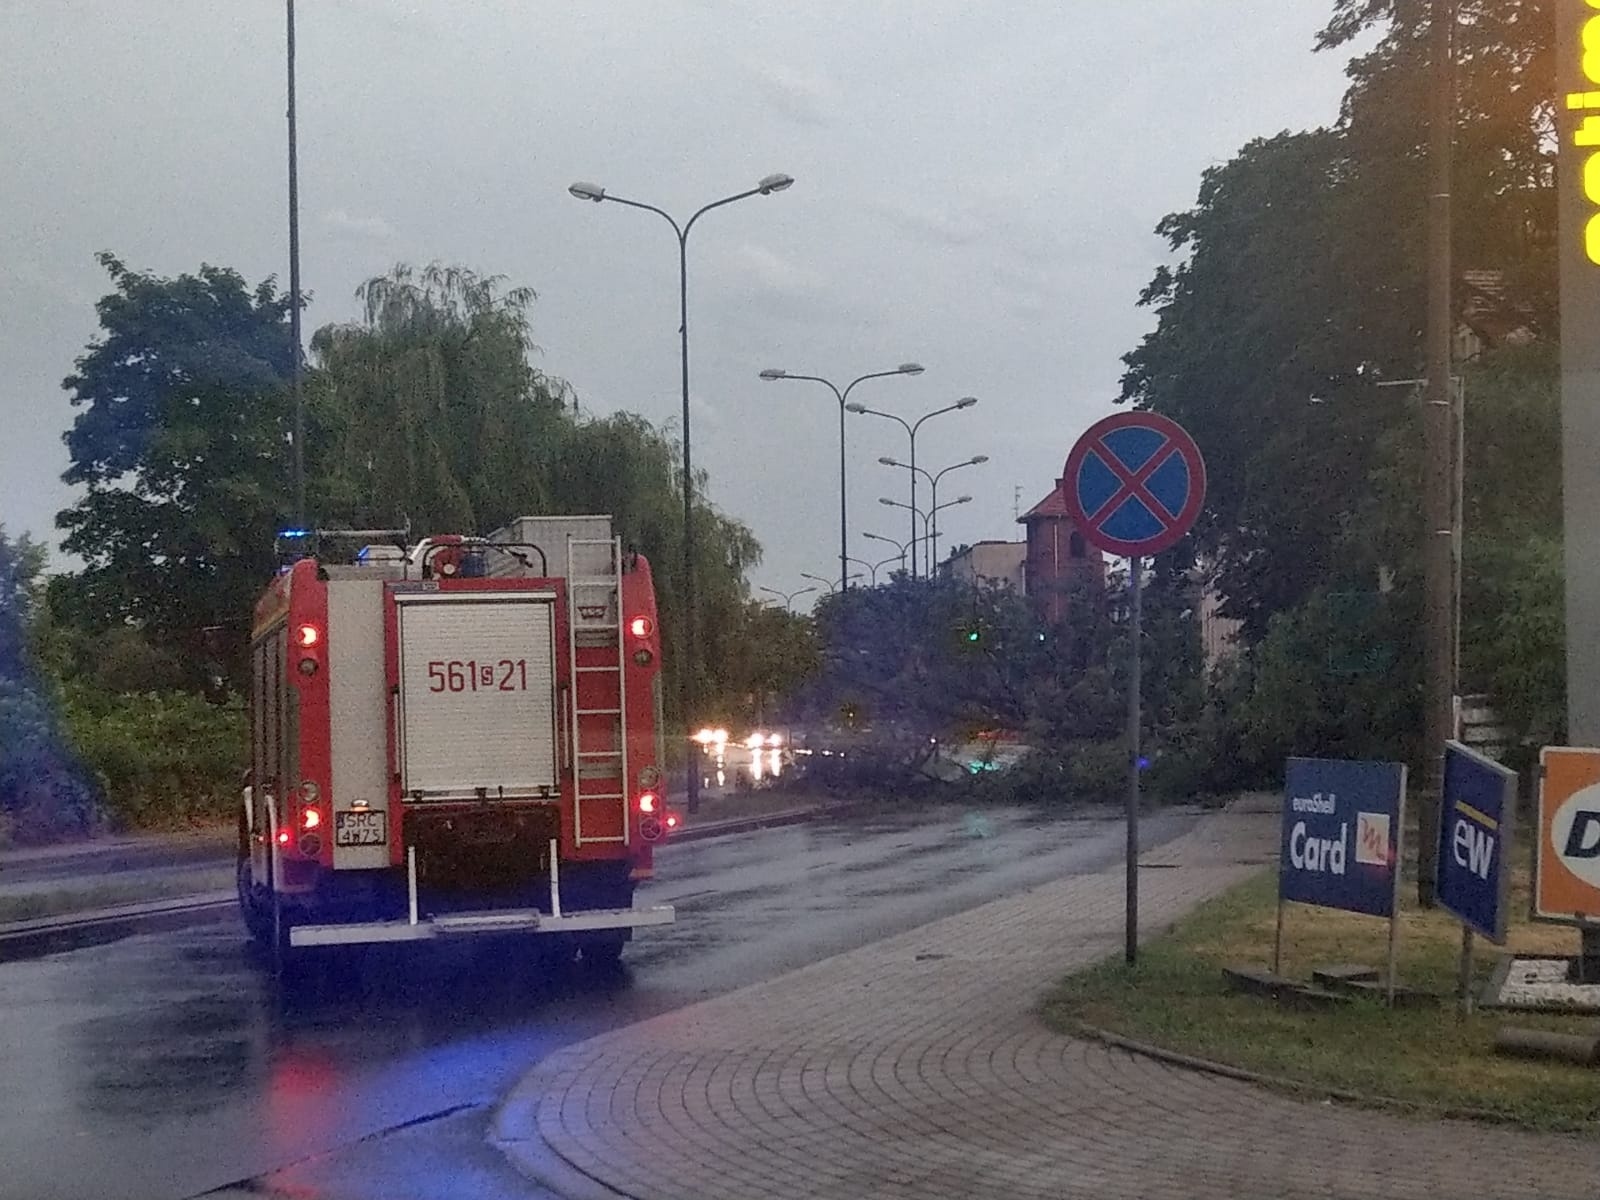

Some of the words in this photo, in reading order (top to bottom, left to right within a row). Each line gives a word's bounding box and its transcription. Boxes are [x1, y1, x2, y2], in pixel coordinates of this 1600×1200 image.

[1293, 792, 1336, 814] euroShell
[347, 813, 376, 828] SRC
[1290, 820, 1347, 875] Card
